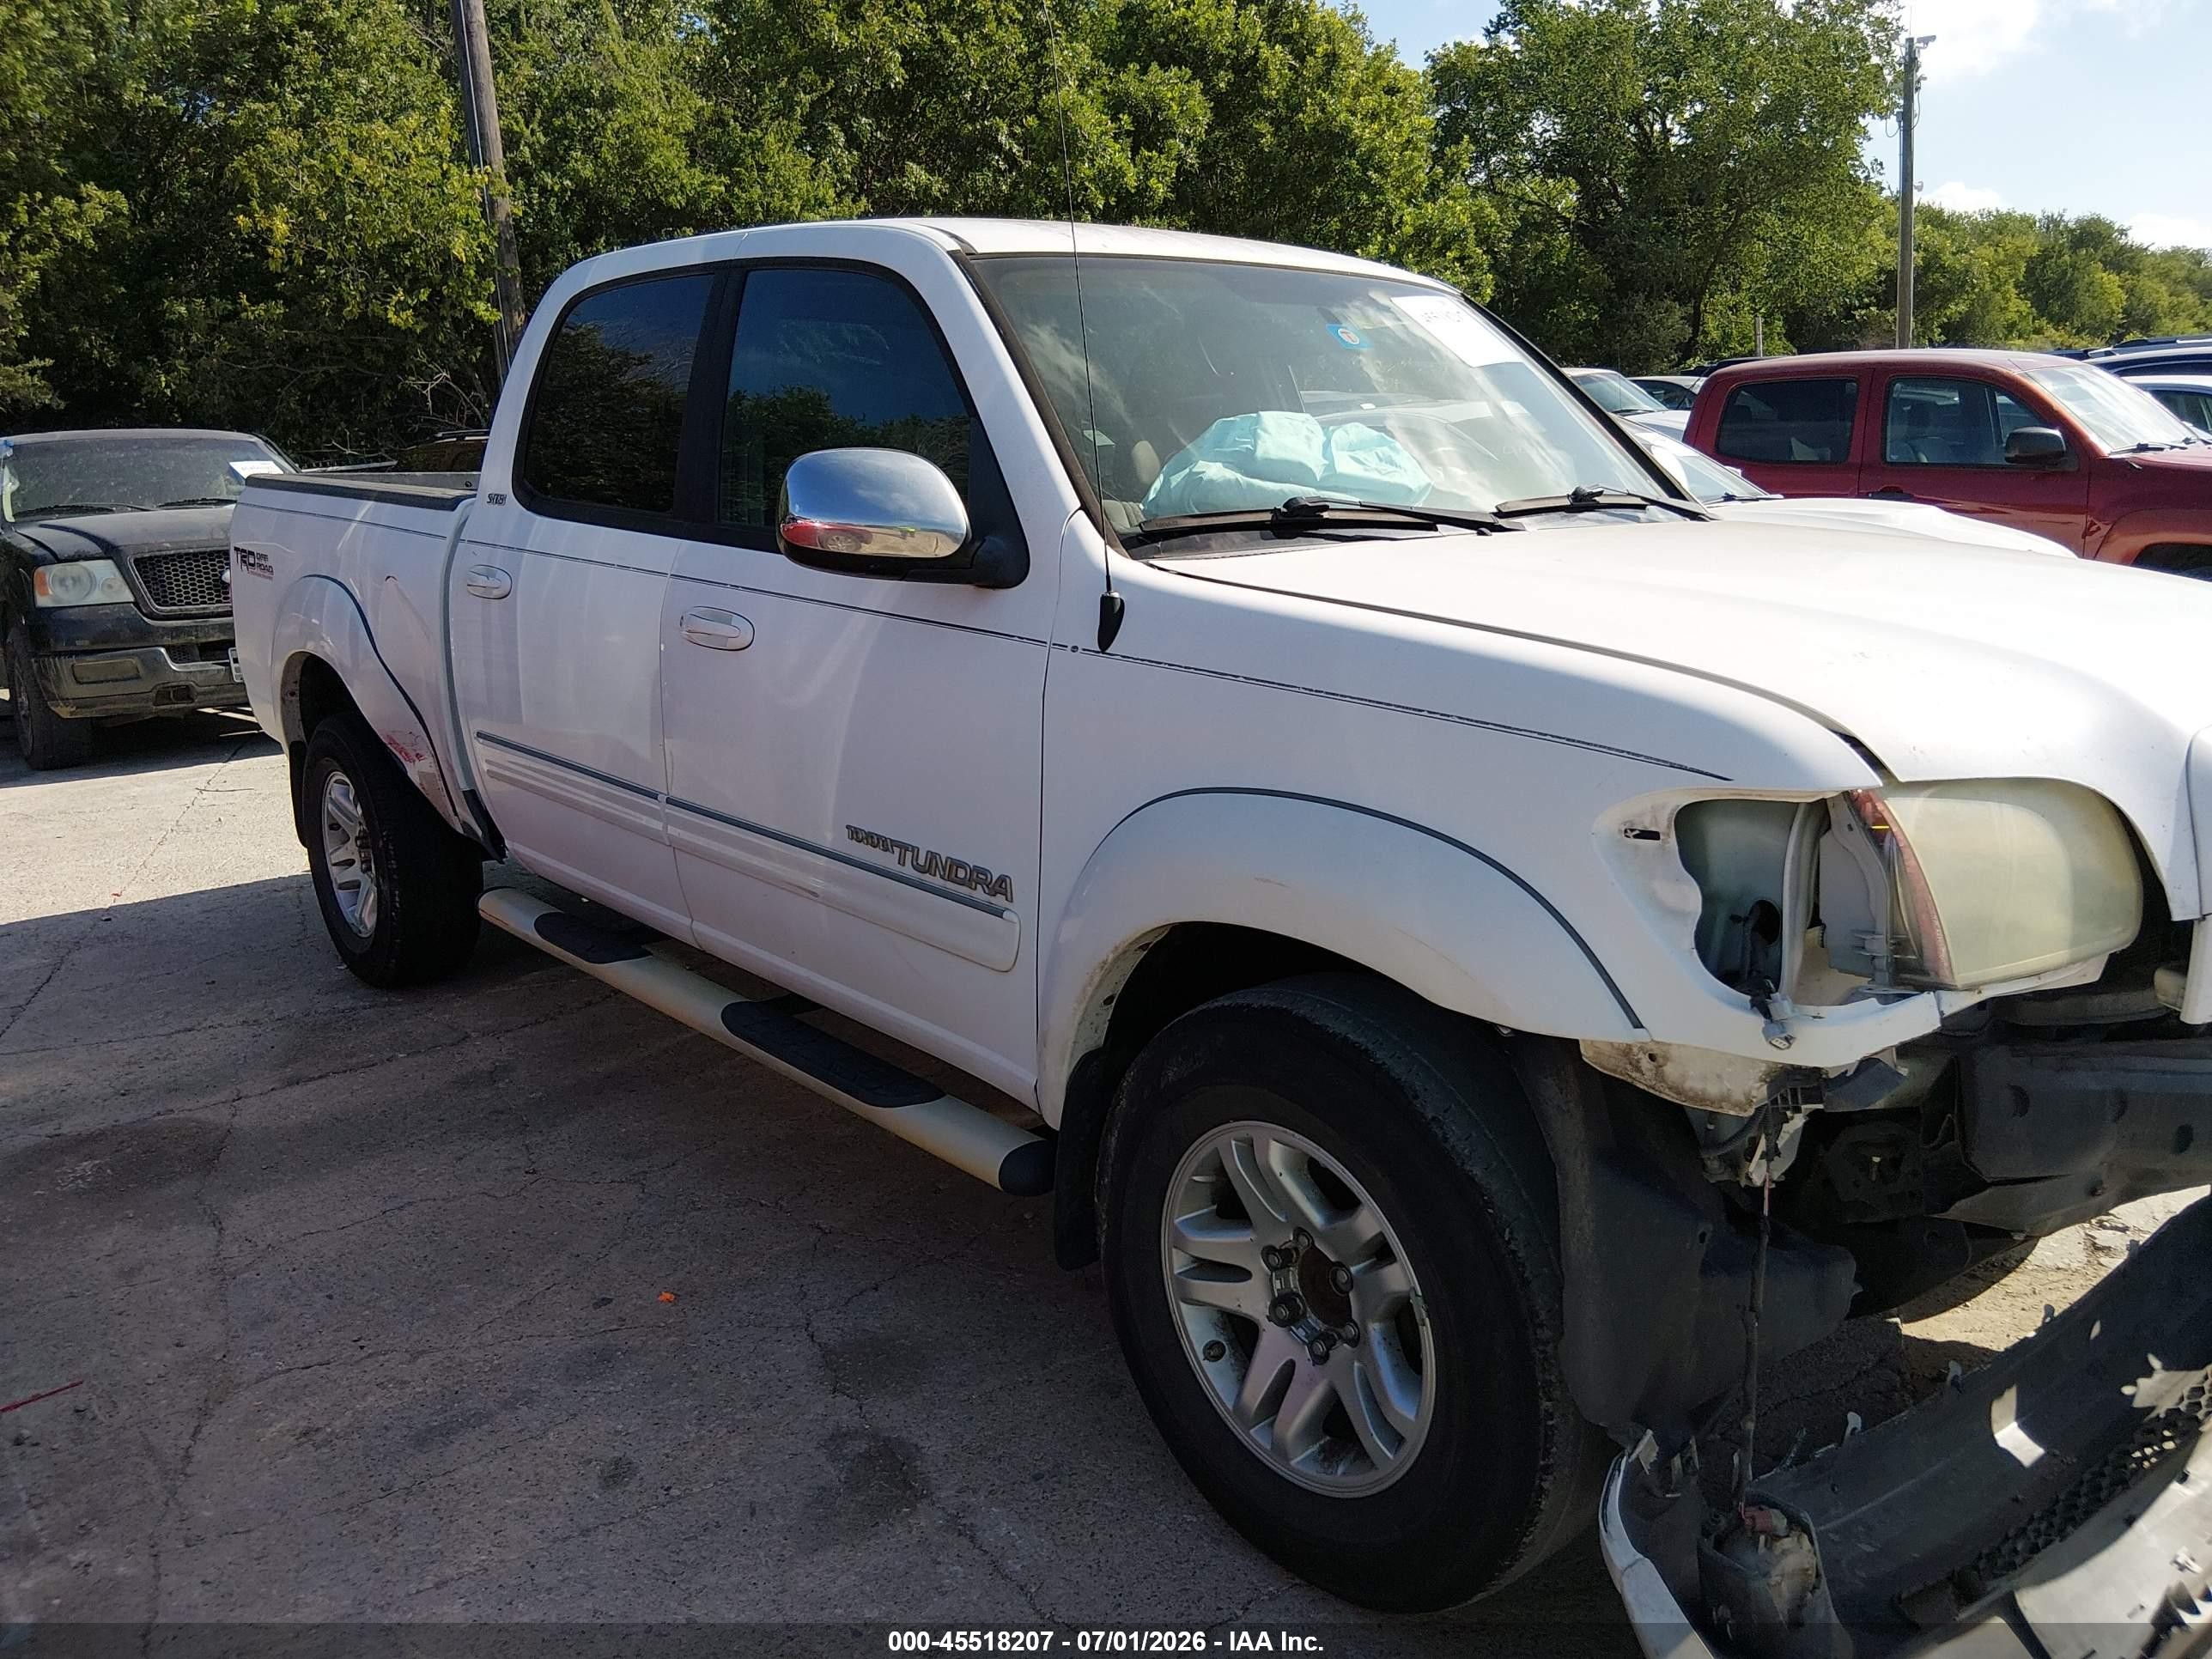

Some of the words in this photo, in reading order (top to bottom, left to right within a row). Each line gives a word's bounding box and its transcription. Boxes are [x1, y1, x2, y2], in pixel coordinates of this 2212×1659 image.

[233, 545, 256, 572] TRD
[256, 562, 275, 574] ROAD
[891, 838, 1014, 902] TUNDRA
